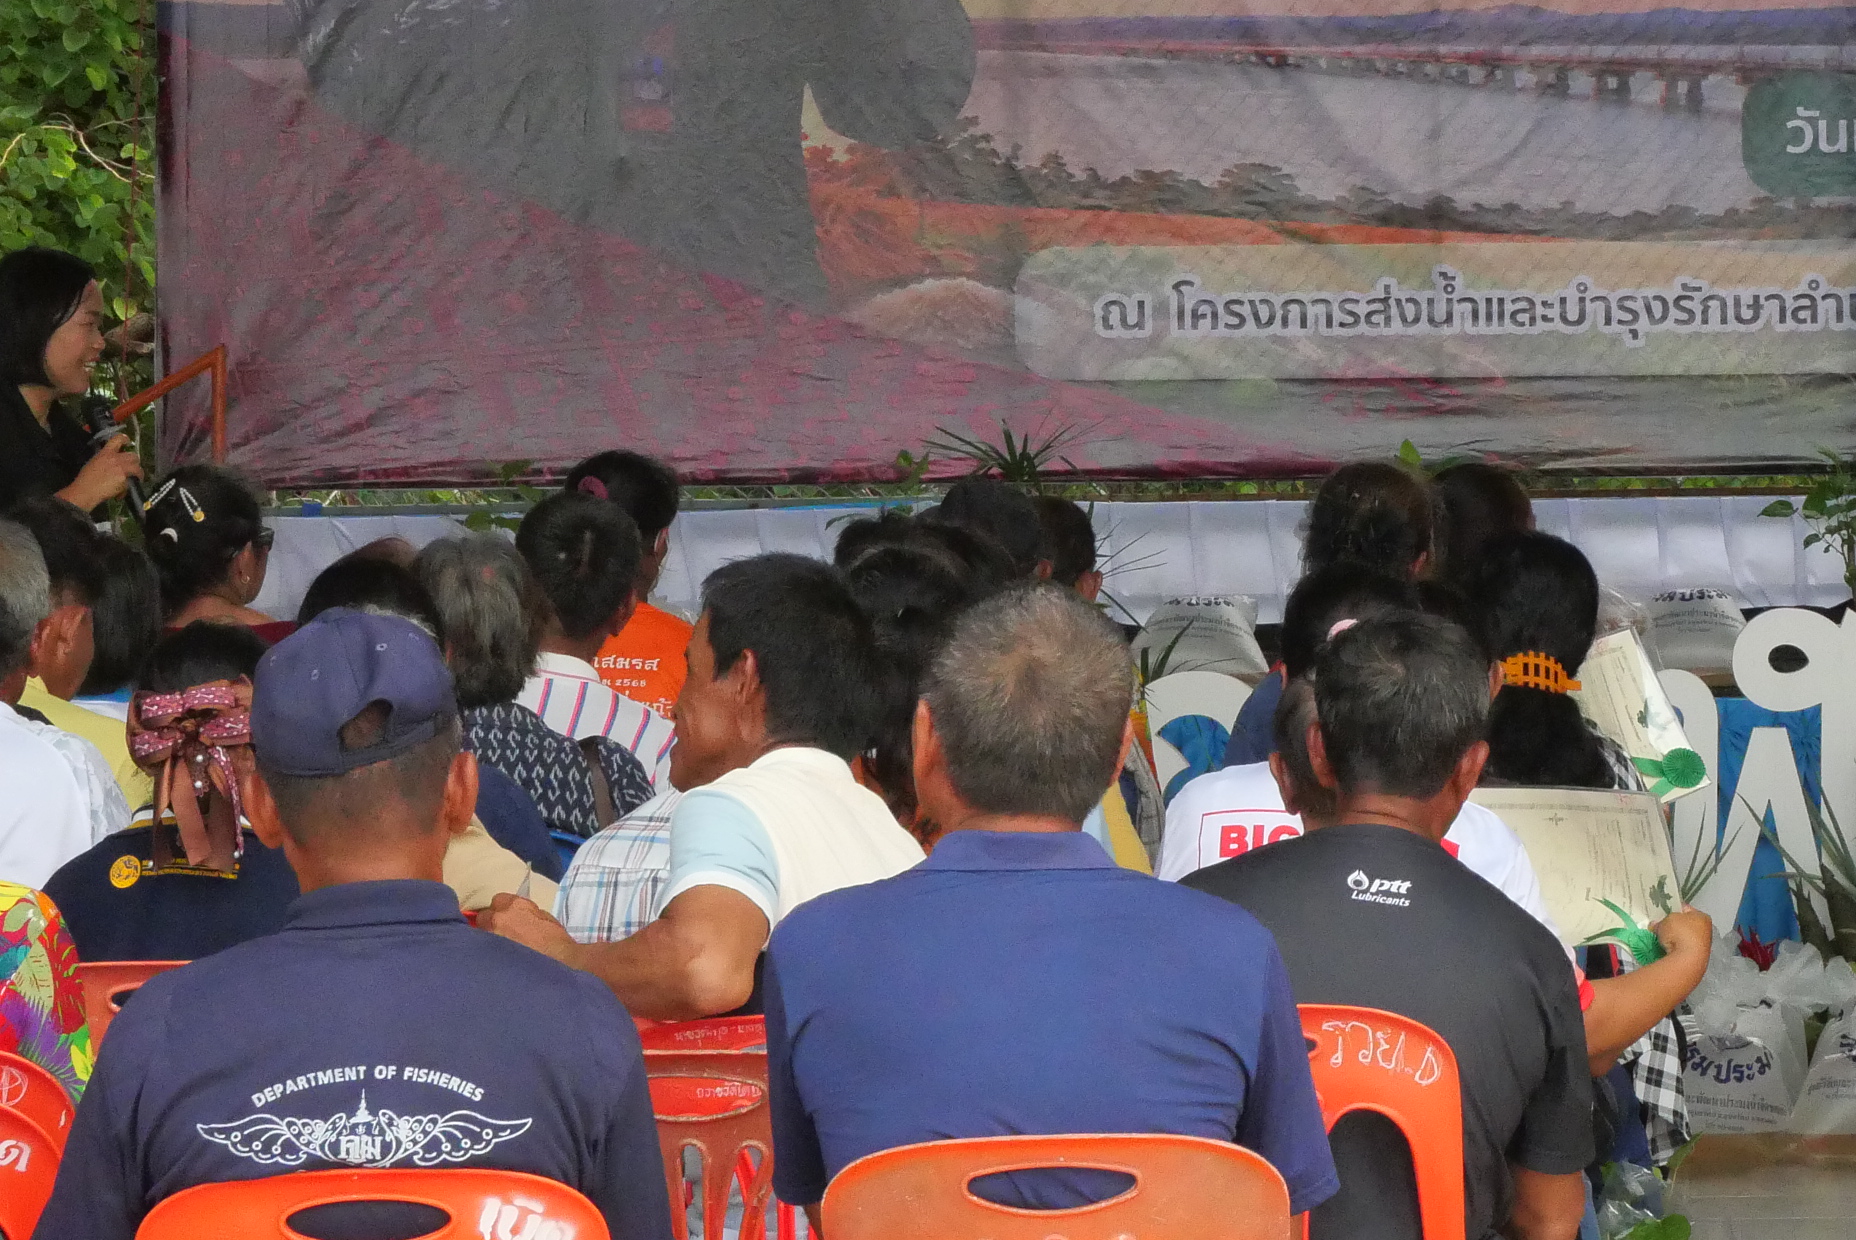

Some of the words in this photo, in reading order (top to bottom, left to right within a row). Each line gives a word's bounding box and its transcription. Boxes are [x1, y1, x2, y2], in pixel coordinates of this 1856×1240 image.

[1101, 294, 1146, 332] ณ
[1351, 889, 1411, 907] Lubricants
[1370, 877, 1413, 894] ptt
[251, 1065, 367, 1108] DEPARTMENT
[374, 1064, 397, 1080] OF
[403, 1066, 485, 1102] FISHERIES
